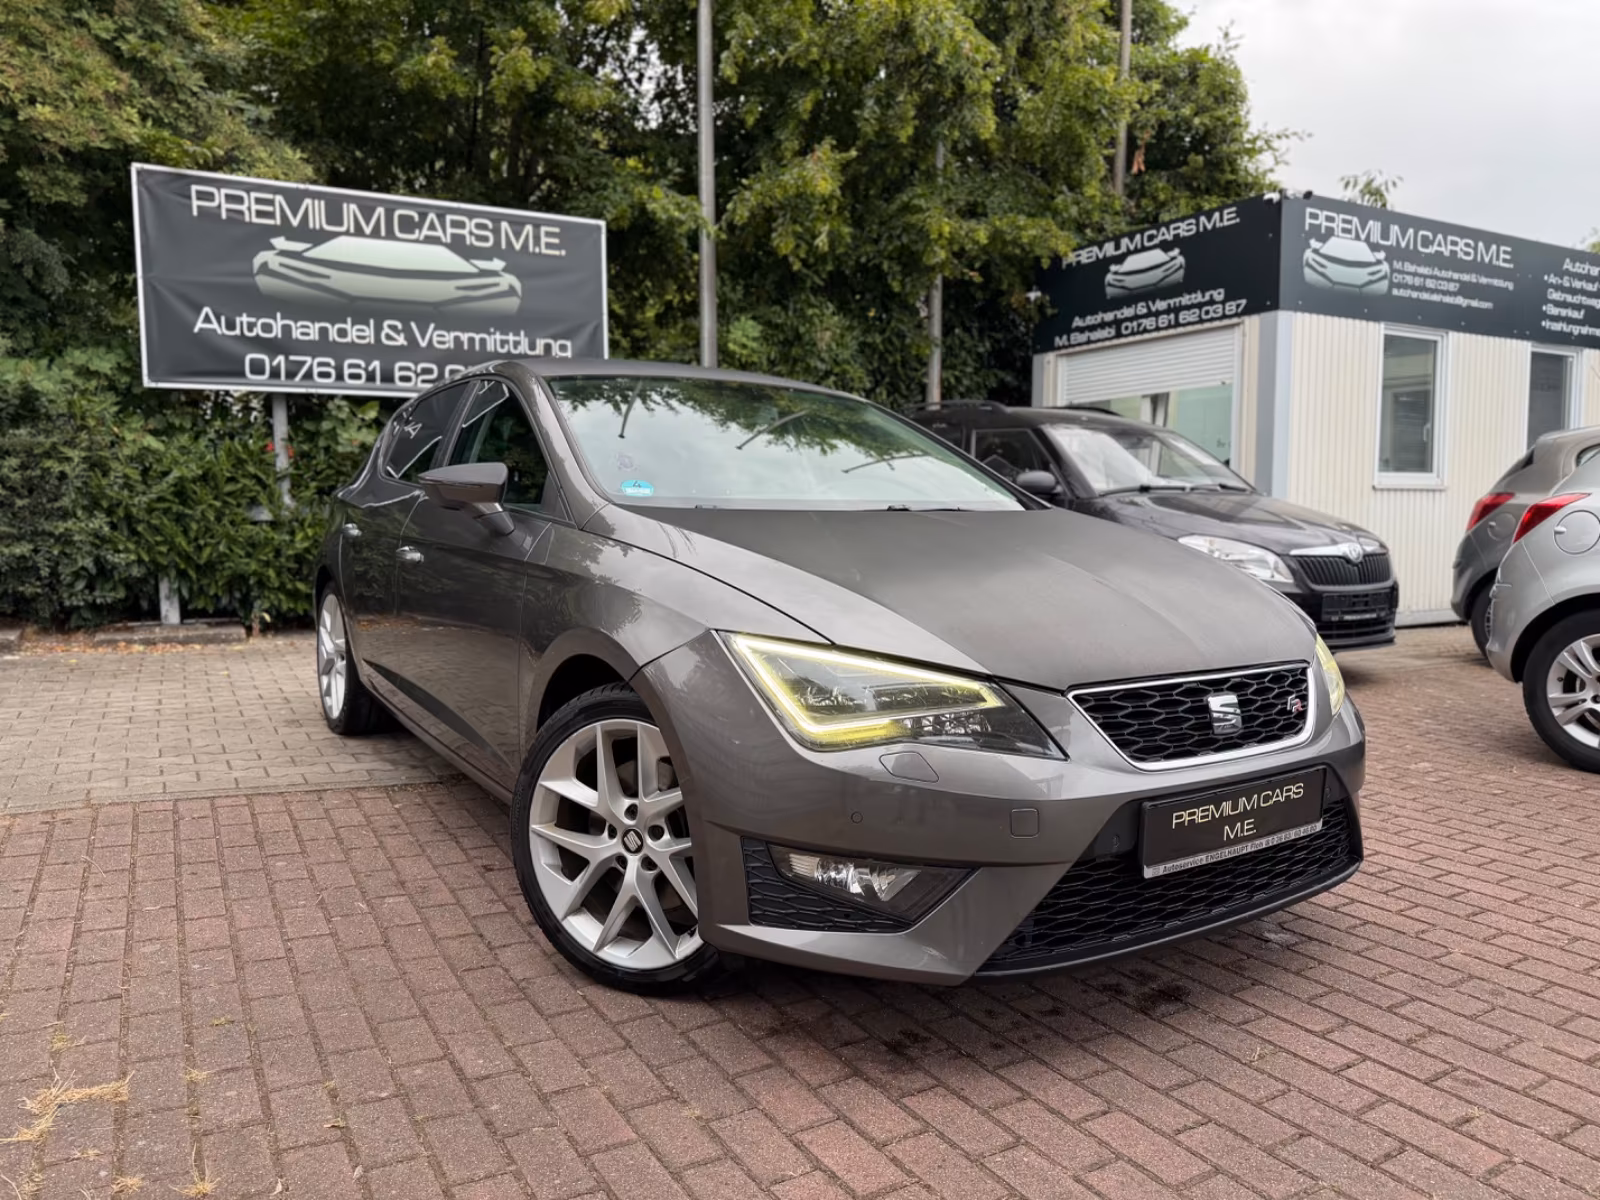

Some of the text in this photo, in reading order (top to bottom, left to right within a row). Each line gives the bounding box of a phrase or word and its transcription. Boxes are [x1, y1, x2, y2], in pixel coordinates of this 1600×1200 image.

[190, 184, 566, 257] PREMIUM CARS M.E.
[1143, 218, 1197, 247] CARS
[1200, 207, 1240, 232] M.E.
[1305, 207, 1514, 268] PREMIUM CARS M.E.
[1433, 266, 1470, 282] Autohandel
[1477, 274, 1514, 291] Vermittlung
[1054, 333, 1069, 349] M.
[1121, 316, 1157, 336] 0176
[1158, 312, 1175, 329] 61
[1178, 307, 1201, 324] 62
[1201, 303, 1223, 320] 03
[1225, 298, 1248, 316] 87
[1071, 288, 1225, 328] Autohandel & Vermittlung
[194, 306, 572, 358] Autohandel & Vermittlung
[244, 353, 336, 384] 0176
[343, 359, 381, 386] 61
[394, 362, 438, 388] 62
[1172, 782, 1304, 829] PREMIUM CARS
[1223, 818, 1257, 841] M.E.
[1205, 846, 1248, 864] ENGELHAUPT
